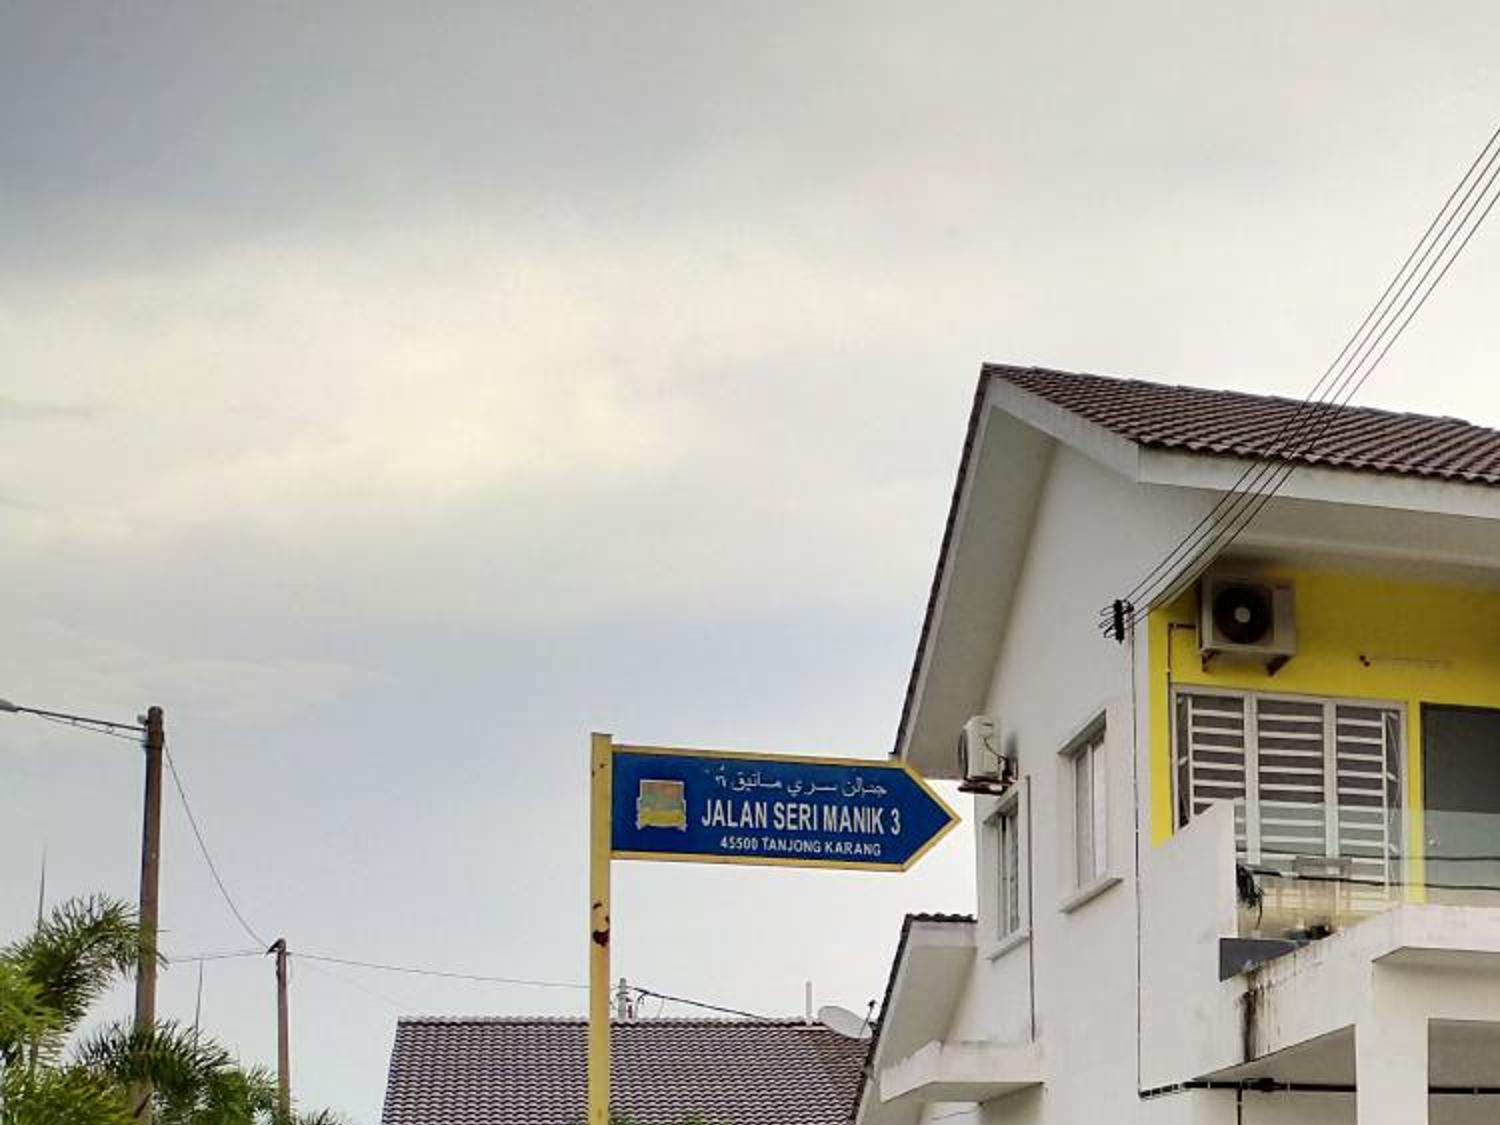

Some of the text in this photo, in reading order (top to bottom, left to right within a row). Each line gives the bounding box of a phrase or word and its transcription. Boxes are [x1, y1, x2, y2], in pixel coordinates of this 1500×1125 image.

[701, 799, 901, 836] JALAN SERI MANIK 3
[720, 835, 881, 857] 45500 TANJONG KARANG
